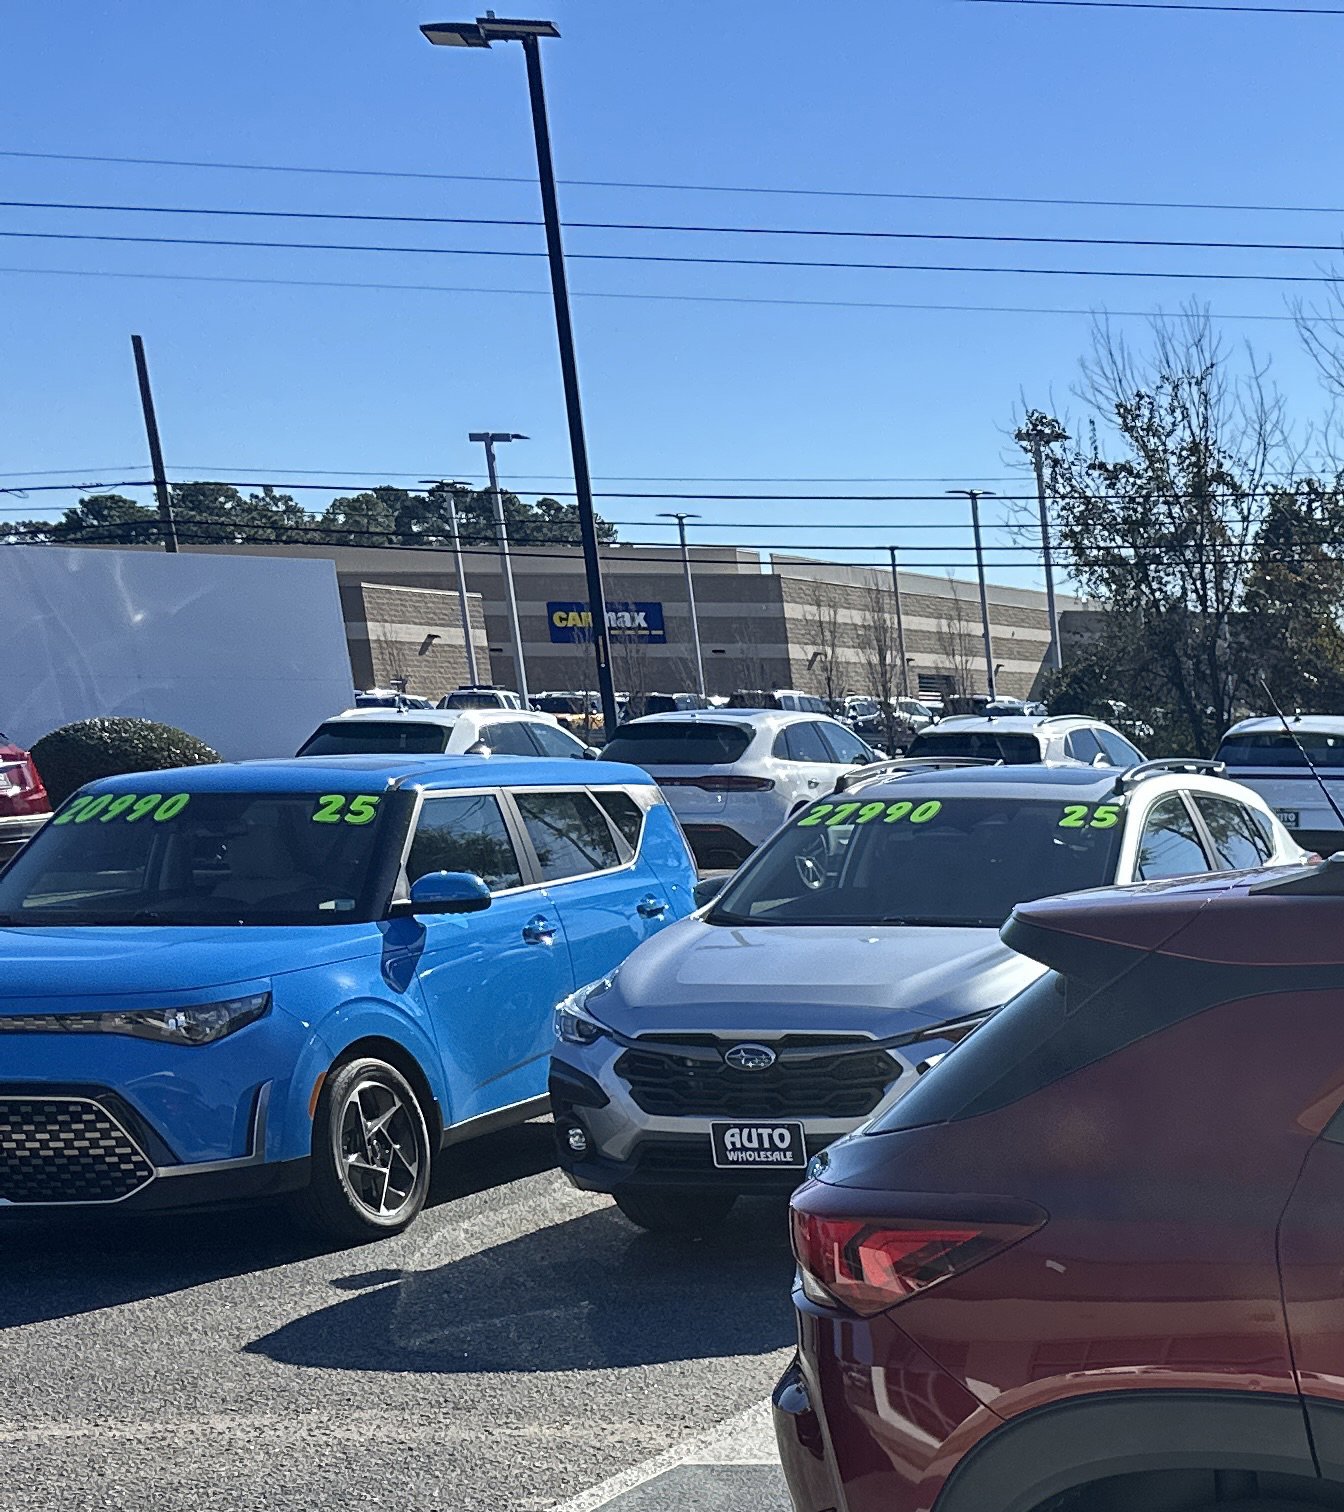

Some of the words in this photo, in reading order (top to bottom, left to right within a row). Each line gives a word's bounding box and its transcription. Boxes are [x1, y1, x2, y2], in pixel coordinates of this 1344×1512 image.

[53, 793, 190, 825] 20990
[313, 795, 380, 825] 25
[798, 801, 943, 826] 27990
[1058, 805, 1121, 828] 25
[724, 1127, 791, 1150] AUTO
[726, 1151, 793, 1161] WHOLESALE
